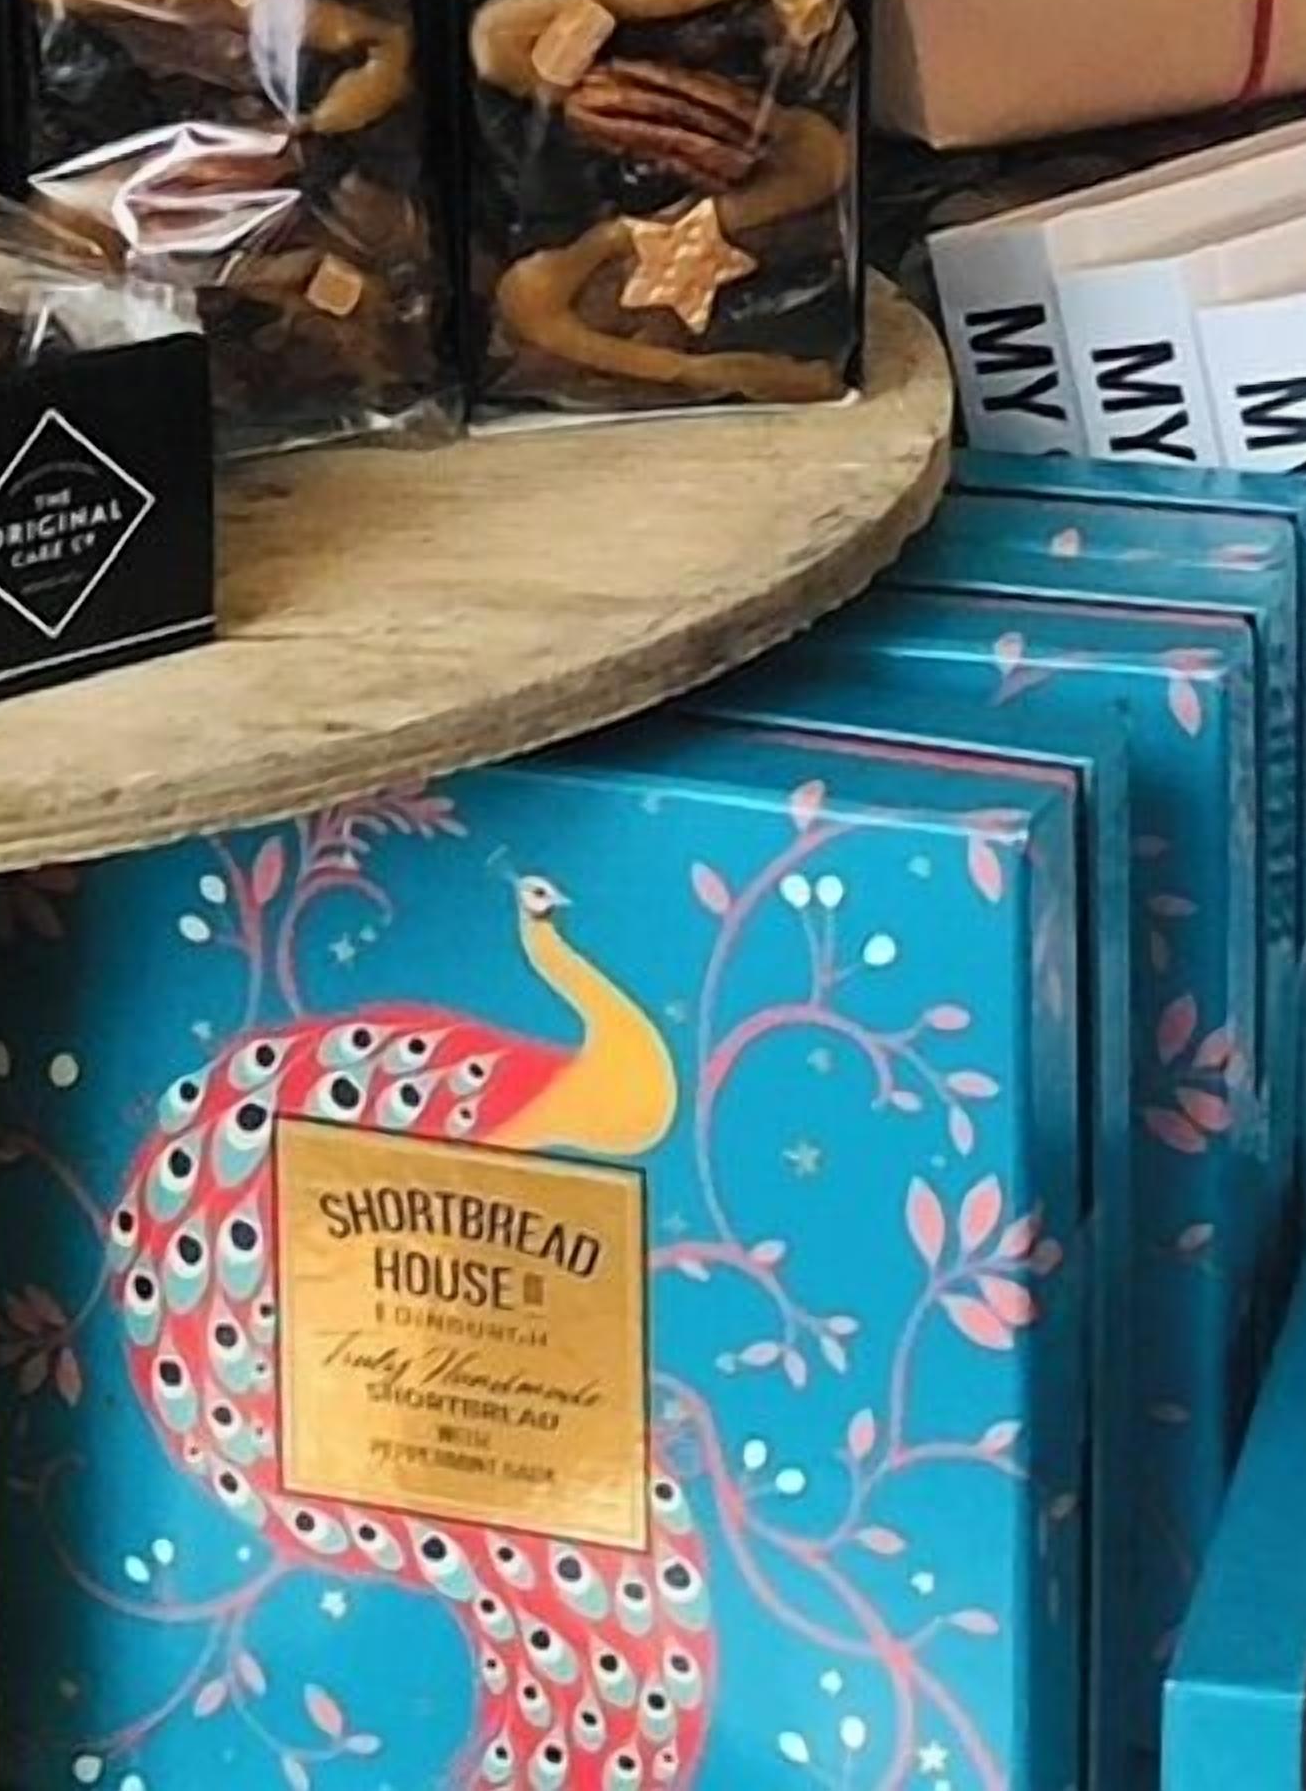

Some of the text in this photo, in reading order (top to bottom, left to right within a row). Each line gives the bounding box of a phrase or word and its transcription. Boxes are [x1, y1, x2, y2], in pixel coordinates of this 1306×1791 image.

[964, 304, 1067, 422] MY
[1091, 341, 1197, 461] MY
[319, 1186, 601, 1281] SHORTBREAD
[373, 1247, 514, 1311] HOUSE
